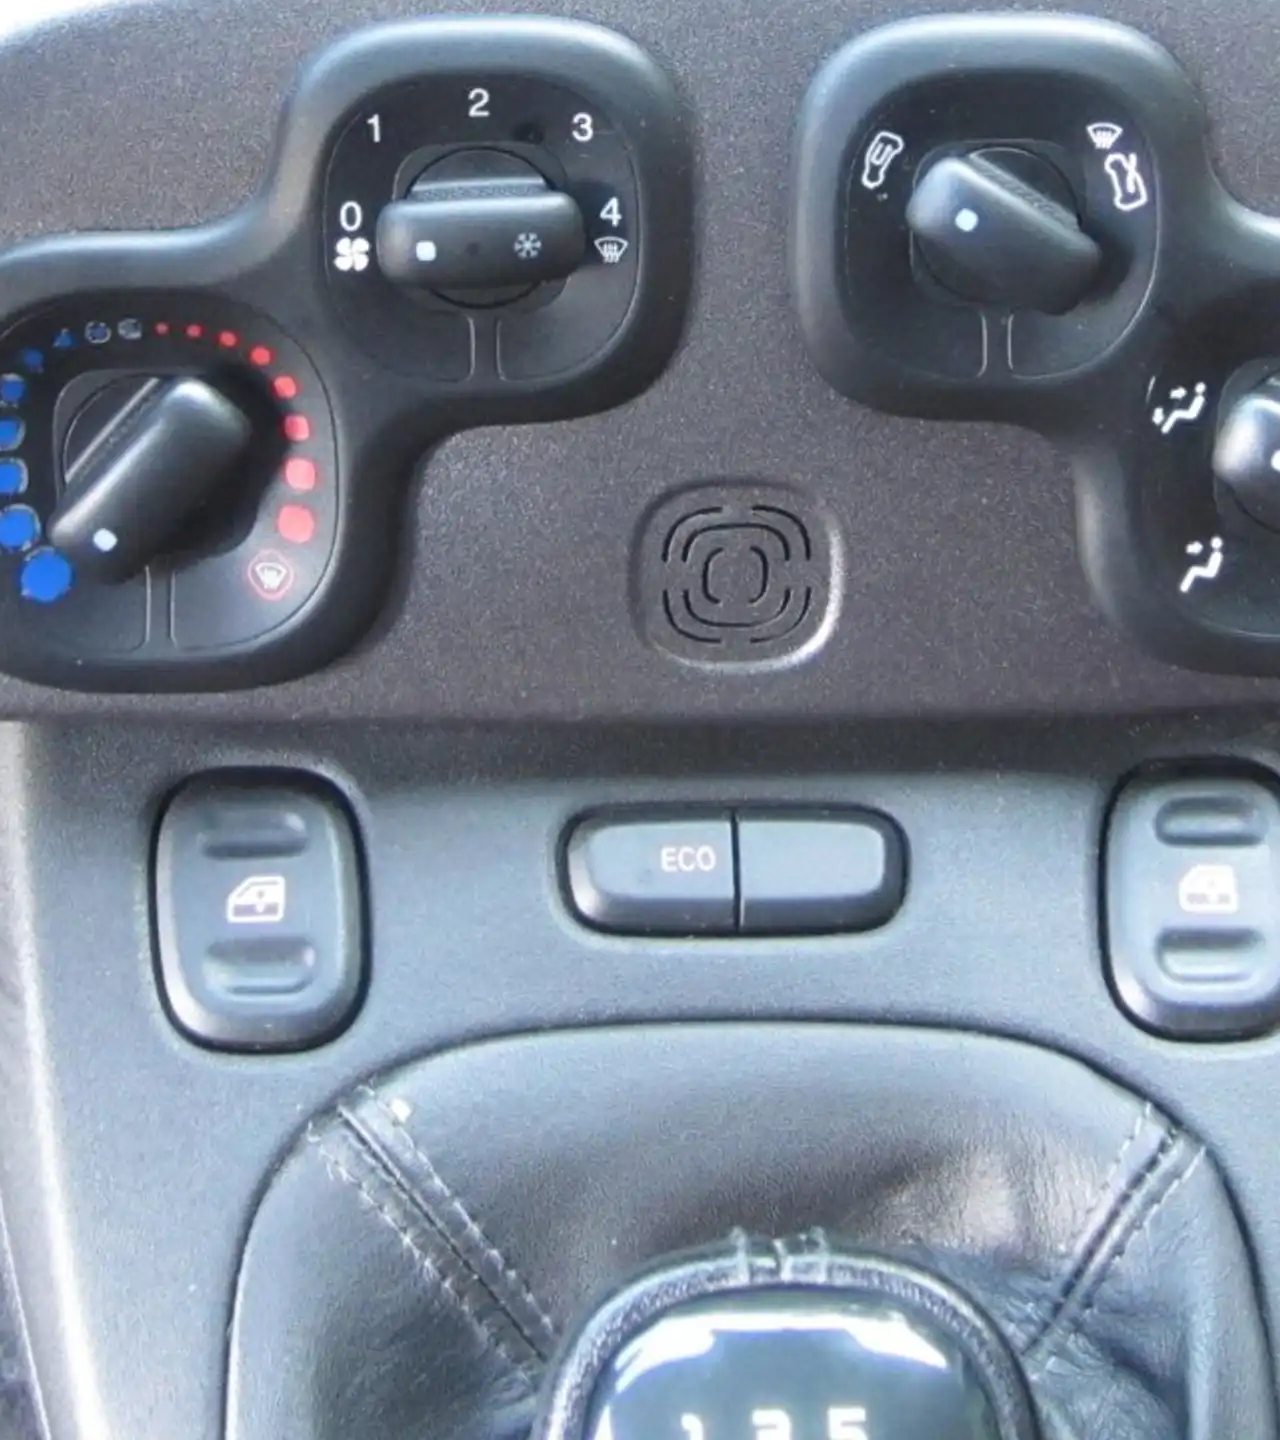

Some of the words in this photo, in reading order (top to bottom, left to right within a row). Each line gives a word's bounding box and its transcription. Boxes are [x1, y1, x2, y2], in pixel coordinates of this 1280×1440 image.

[468, 89, 490, 117] 2
[367, 116, 383, 142] 1
[571, 114, 594, 142] 3
[339, 202, 363, 229] 0
[599, 198, 622, 227] 4
[660, 845, 716, 872] ECO
